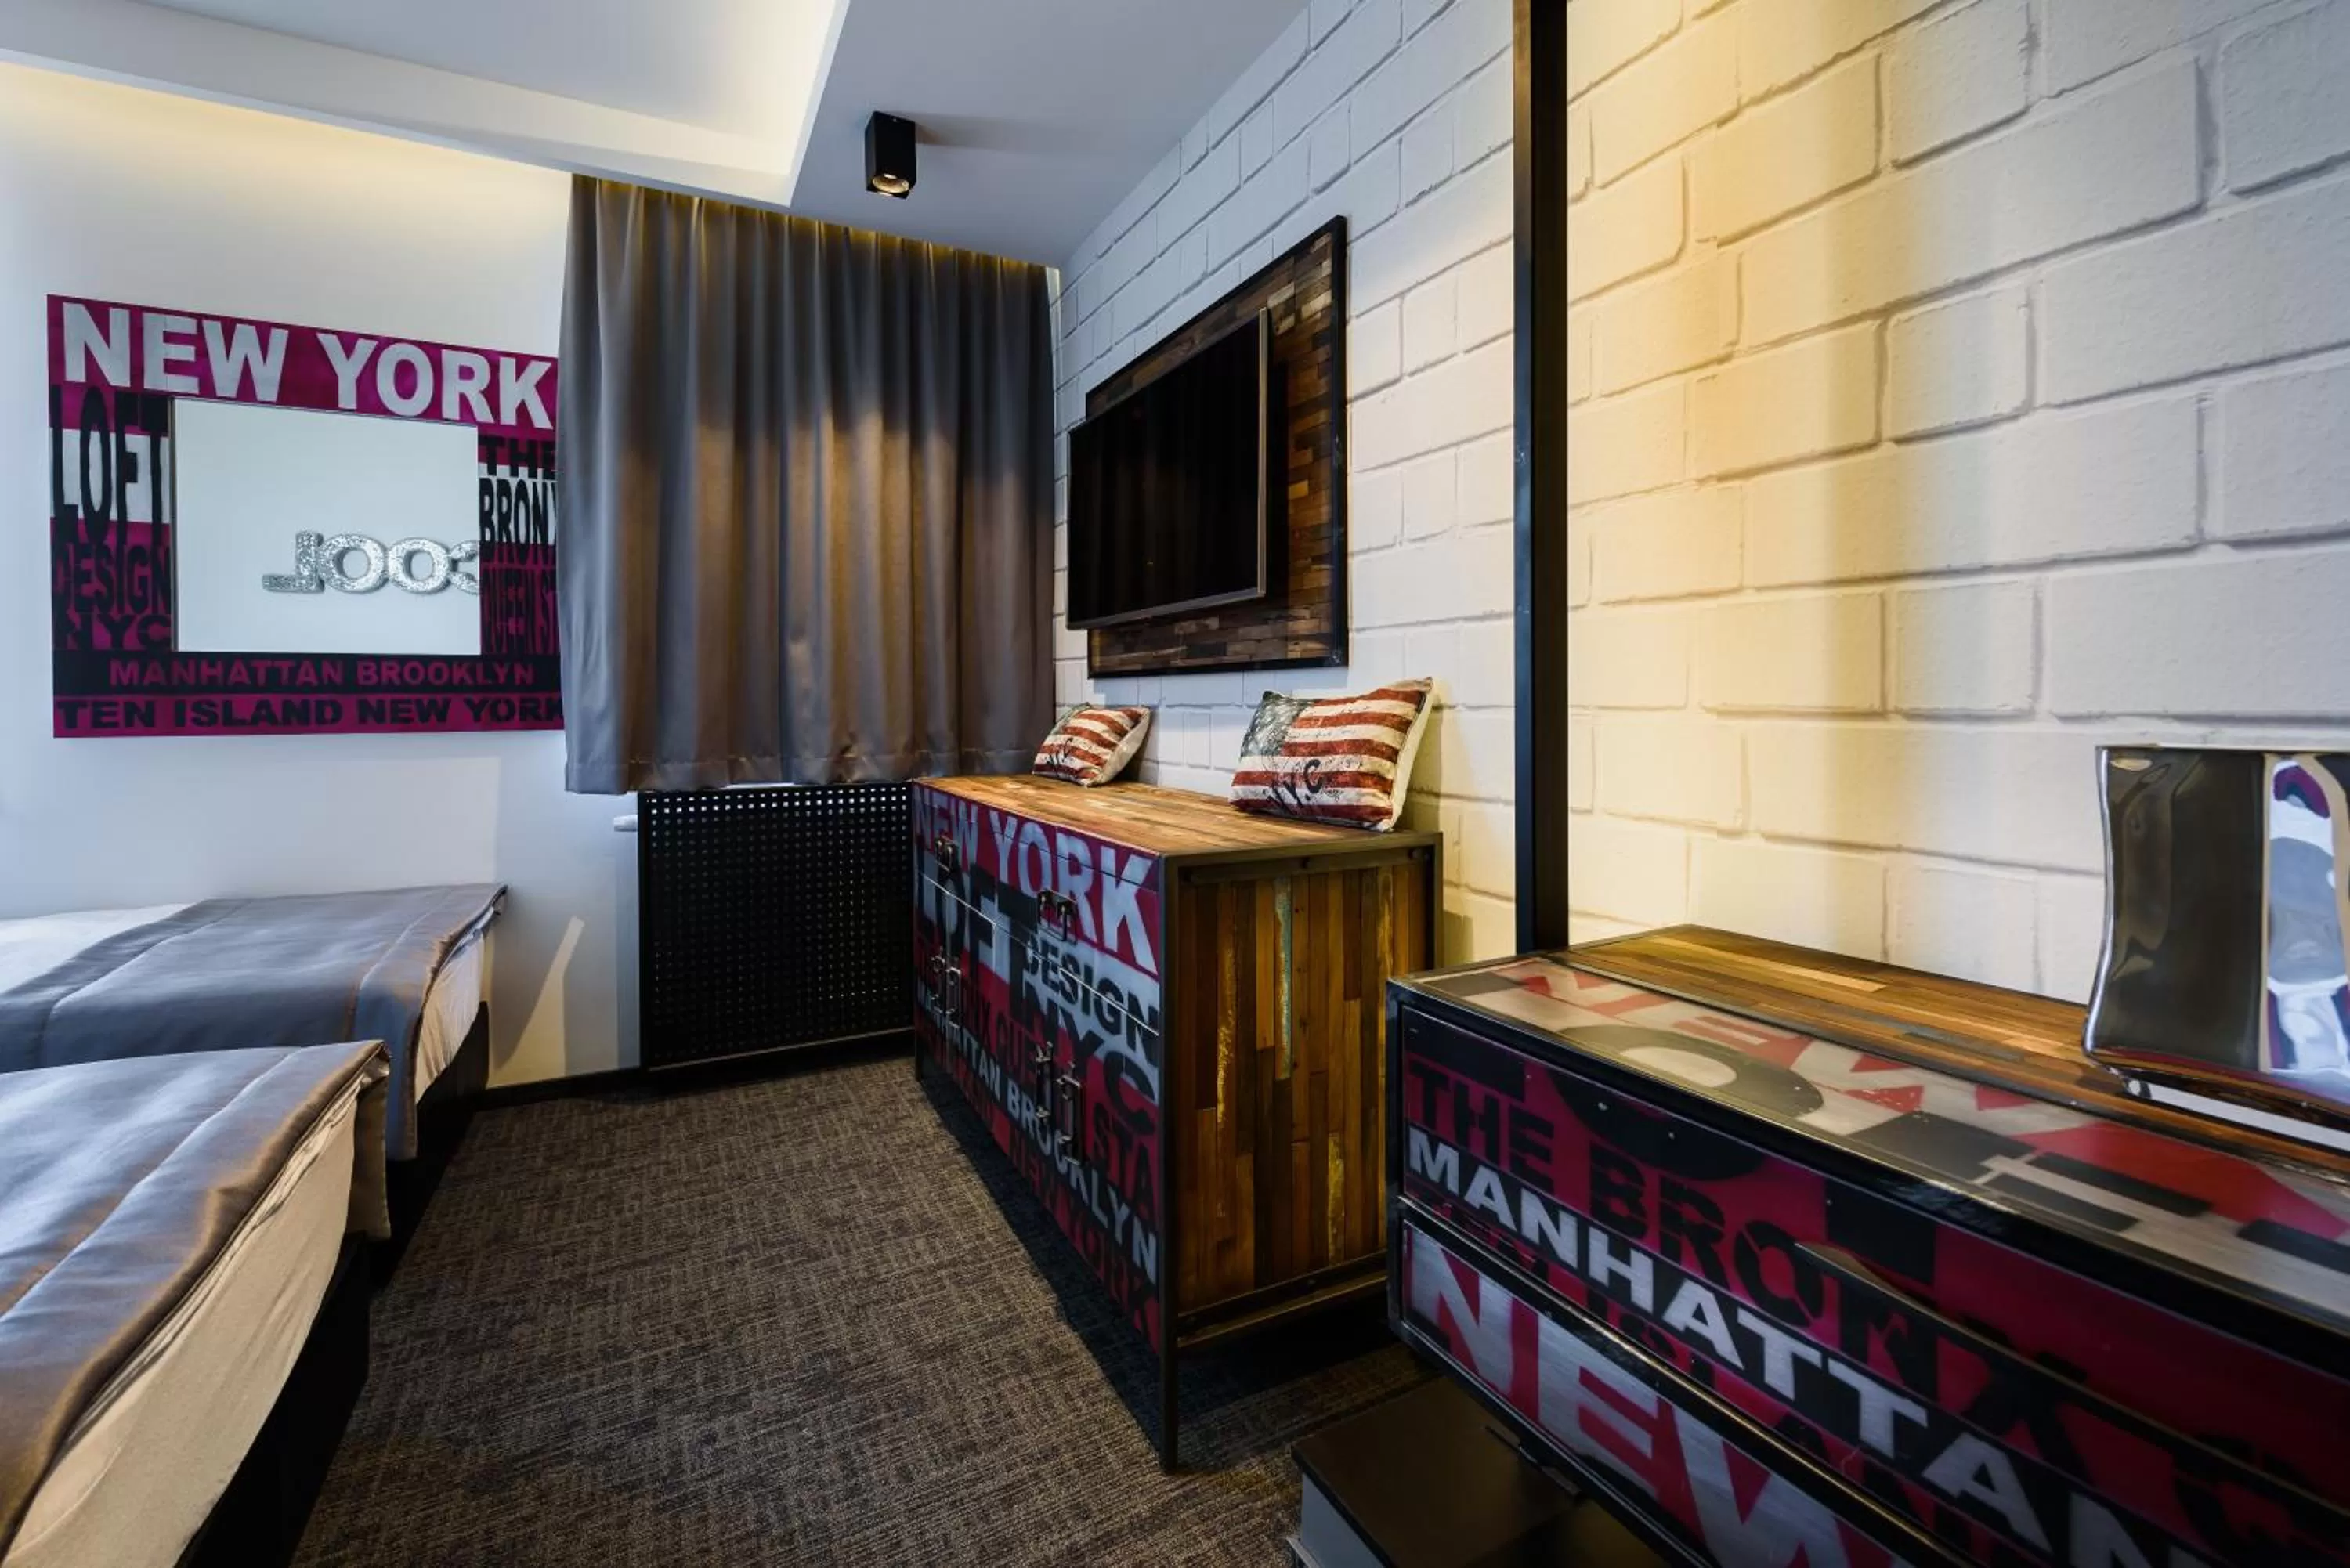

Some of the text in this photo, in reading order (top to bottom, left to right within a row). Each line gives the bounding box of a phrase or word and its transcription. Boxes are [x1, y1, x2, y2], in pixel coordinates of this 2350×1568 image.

[63, 302, 553, 430] NEW YORK
[52, 385, 170, 545] LOFT
[52, 544, 171, 615] DESIGN
[58, 697, 563, 728] TEN ISLAND NEW YORK
[109, 658, 534, 687] MANHATTAN BROOKLYN
[914, 785, 978, 874] NEW
[989, 811, 1158, 977] YORK
[1023, 981, 1155, 1136] NYC
[1025, 932, 1159, 1067] DESIGN
[1006, 1075, 1157, 1286] BROOKLYN
[1410, 1064, 1555, 1195] THE
